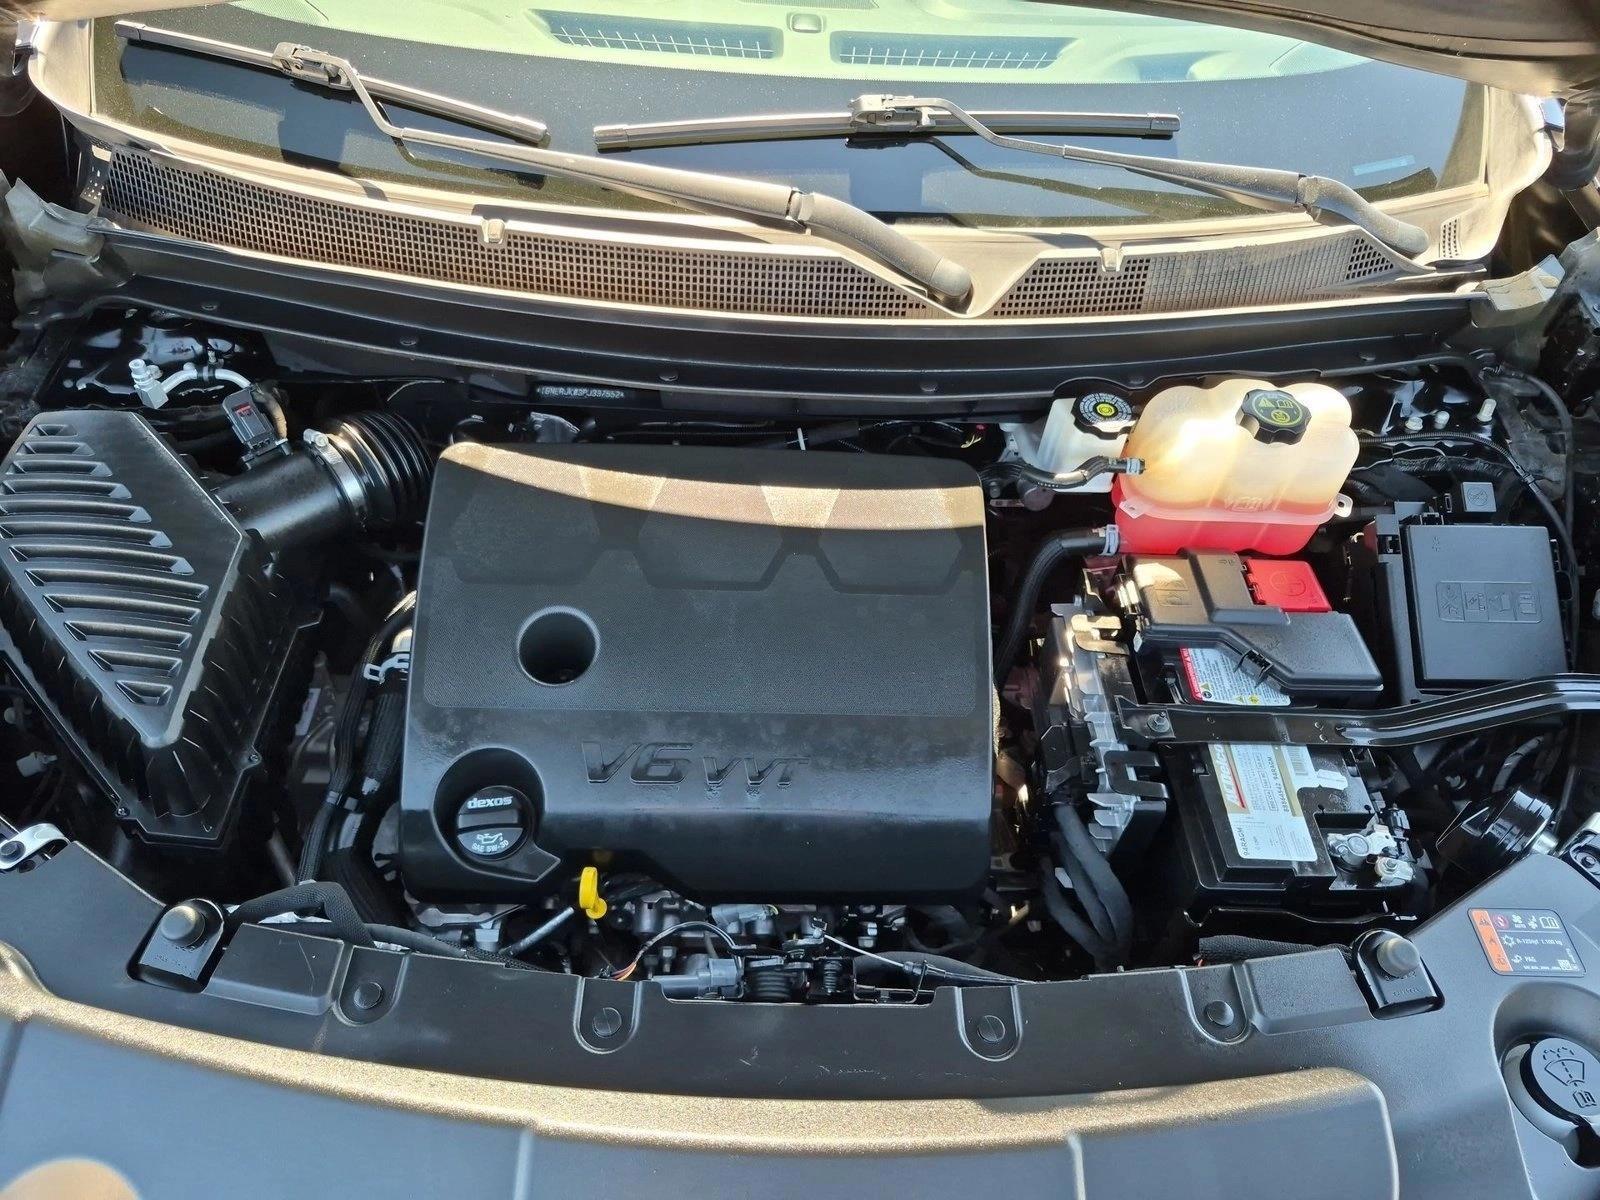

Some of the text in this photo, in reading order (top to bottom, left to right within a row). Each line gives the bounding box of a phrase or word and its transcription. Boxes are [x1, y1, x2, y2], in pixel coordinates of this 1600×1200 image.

[582, 742, 693, 784] V6
[467, 796, 513, 809] dexos
[472, 842, 485, 852] SAE
